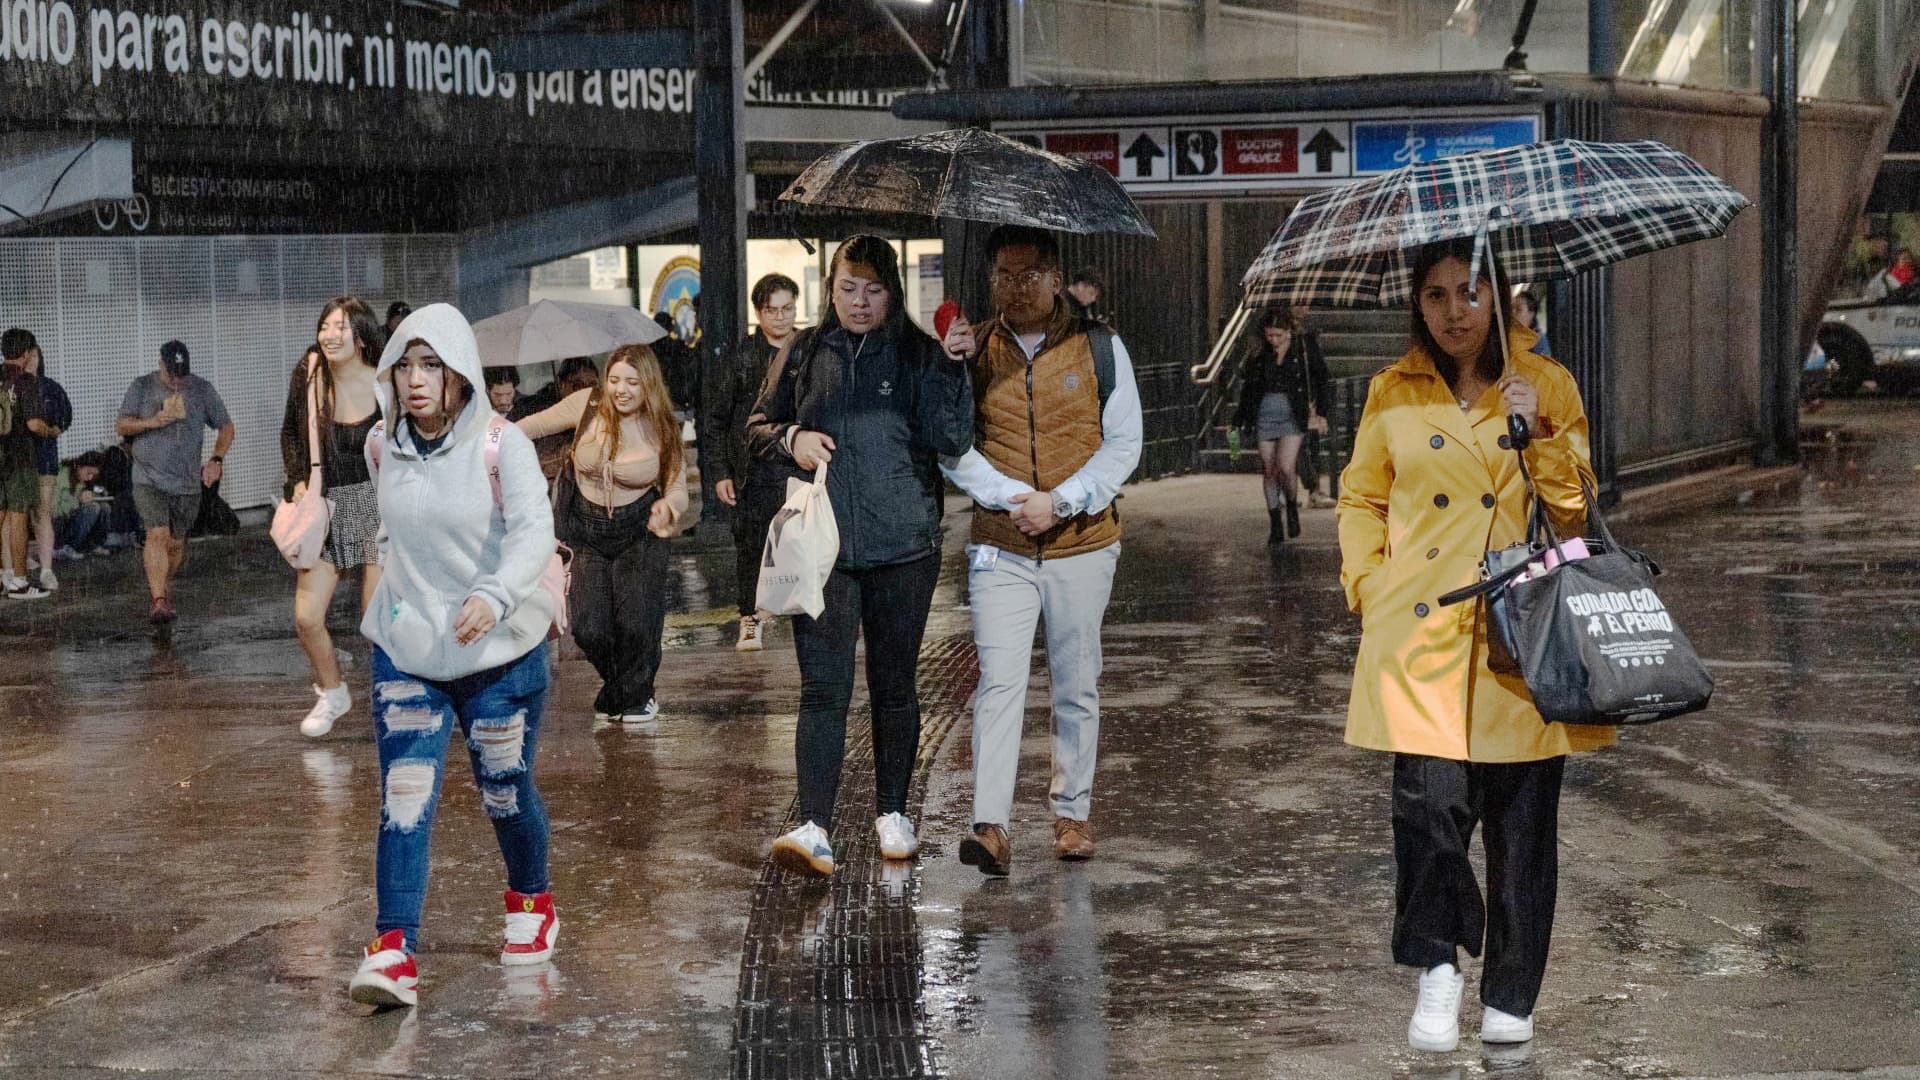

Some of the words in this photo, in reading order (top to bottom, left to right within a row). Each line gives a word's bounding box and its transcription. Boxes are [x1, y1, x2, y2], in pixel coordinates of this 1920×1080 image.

[91, 8, 190, 87] para
[201, 11, 356, 91] escribir,
[364, 21, 395, 88] ni
[1236, 139, 1283, 150] DOCTOR
[1239, 151, 1281, 164] GÁLVEZ
[1566, 592, 1633, 616] CUIDADO
[1604, 613, 1627, 634] EL
[1621, 611, 1674, 634] PERRO
